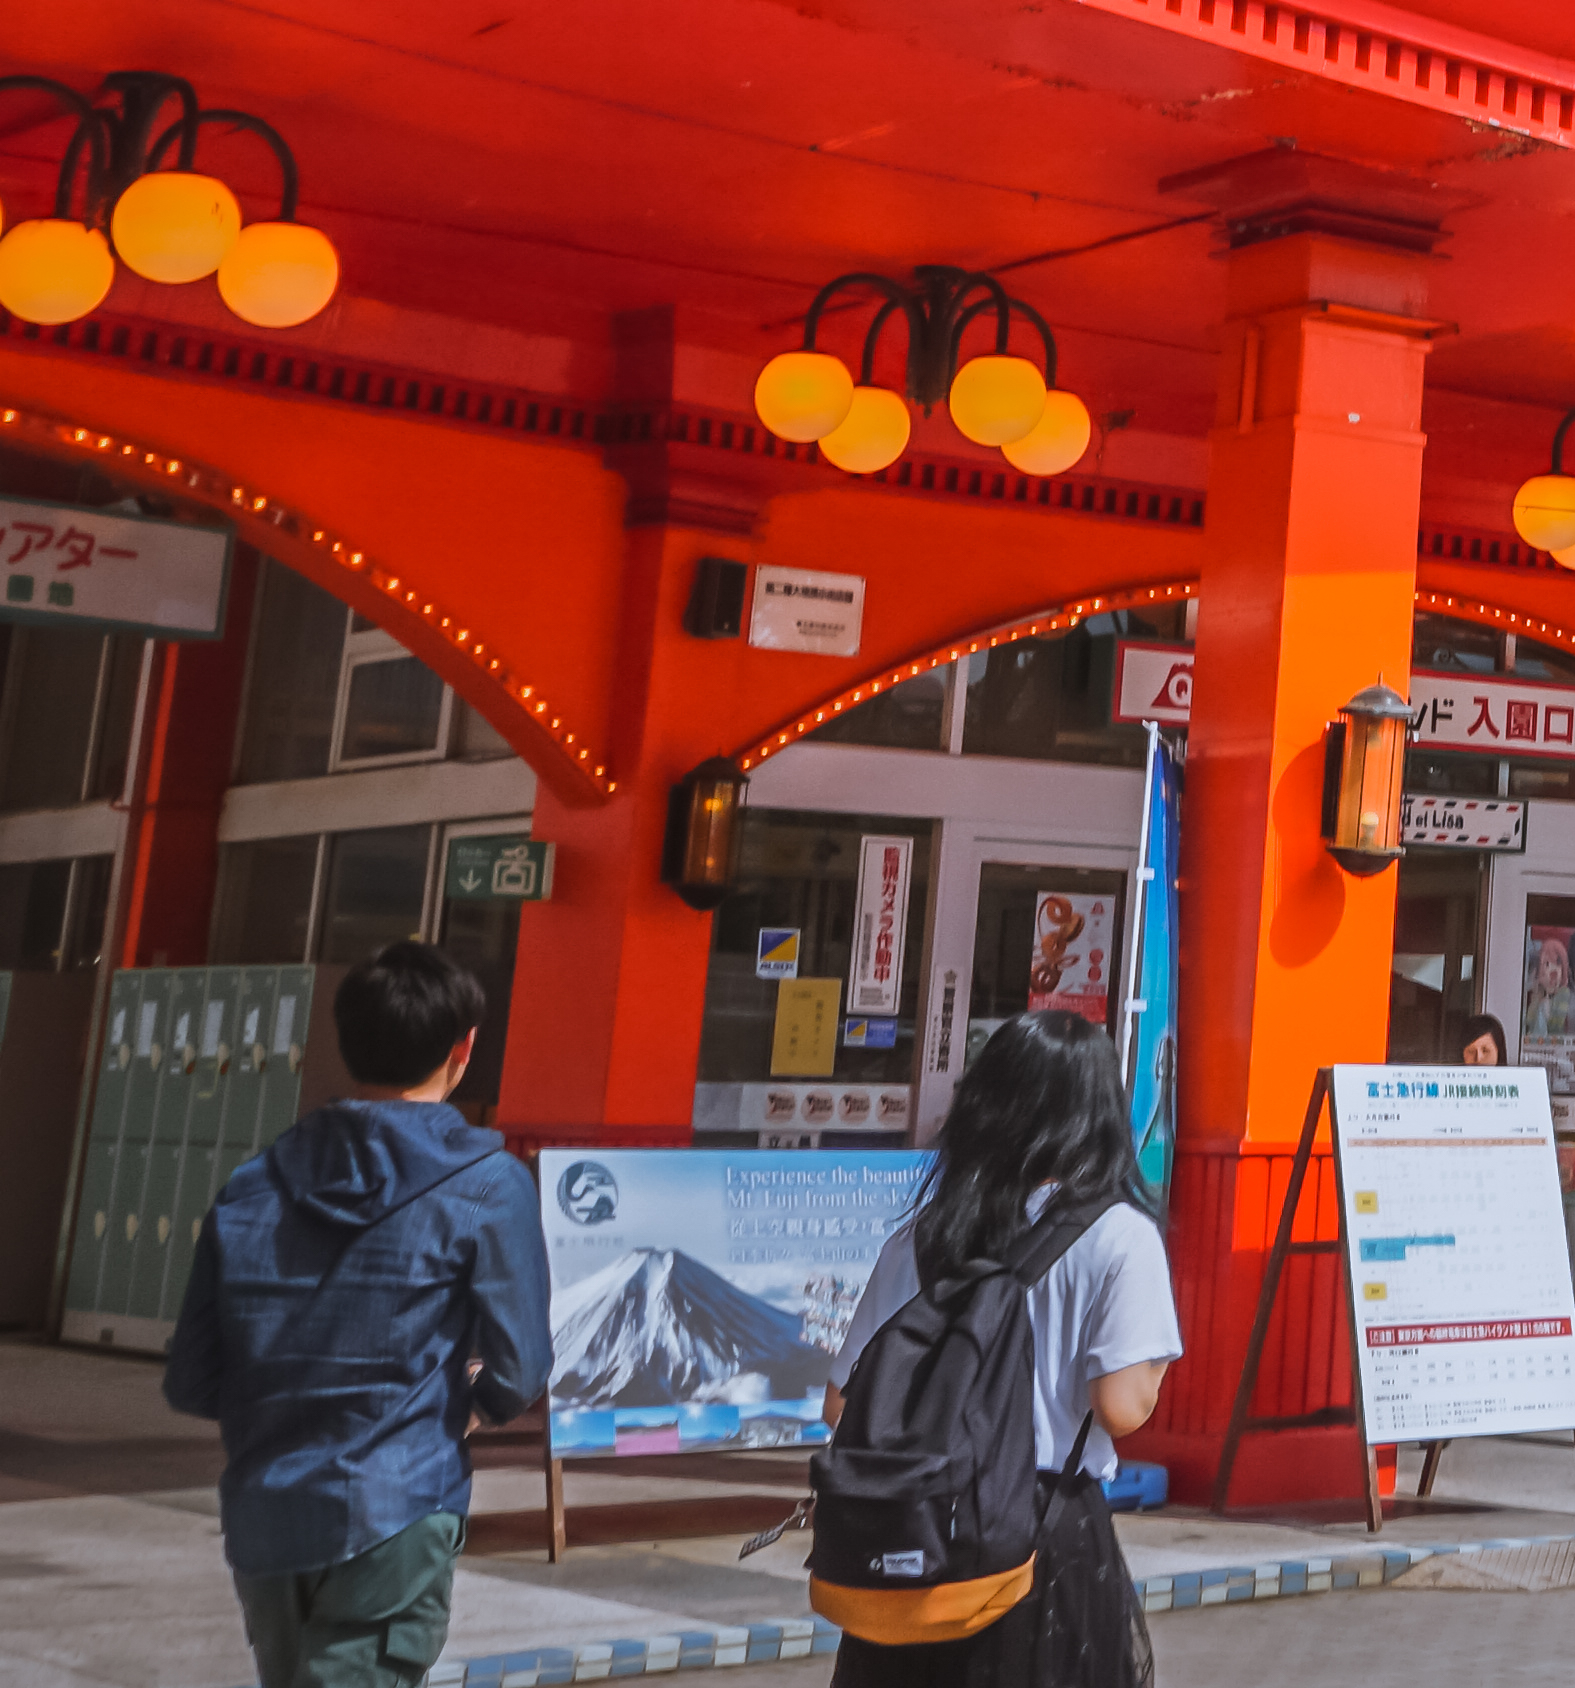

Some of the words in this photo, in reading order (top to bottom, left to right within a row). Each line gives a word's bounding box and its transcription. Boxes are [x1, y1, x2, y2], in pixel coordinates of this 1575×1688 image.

[0, 520, 139, 571] アター
[1467, 696, 1575, 744] 入園口
[727, 1167, 826, 1188] Experience
[831, 1166, 857, 1184] the
[863, 1166, 923, 1184] beautif
[805, 1189, 846, 1207] from
[852, 1188, 878, 1207] the
